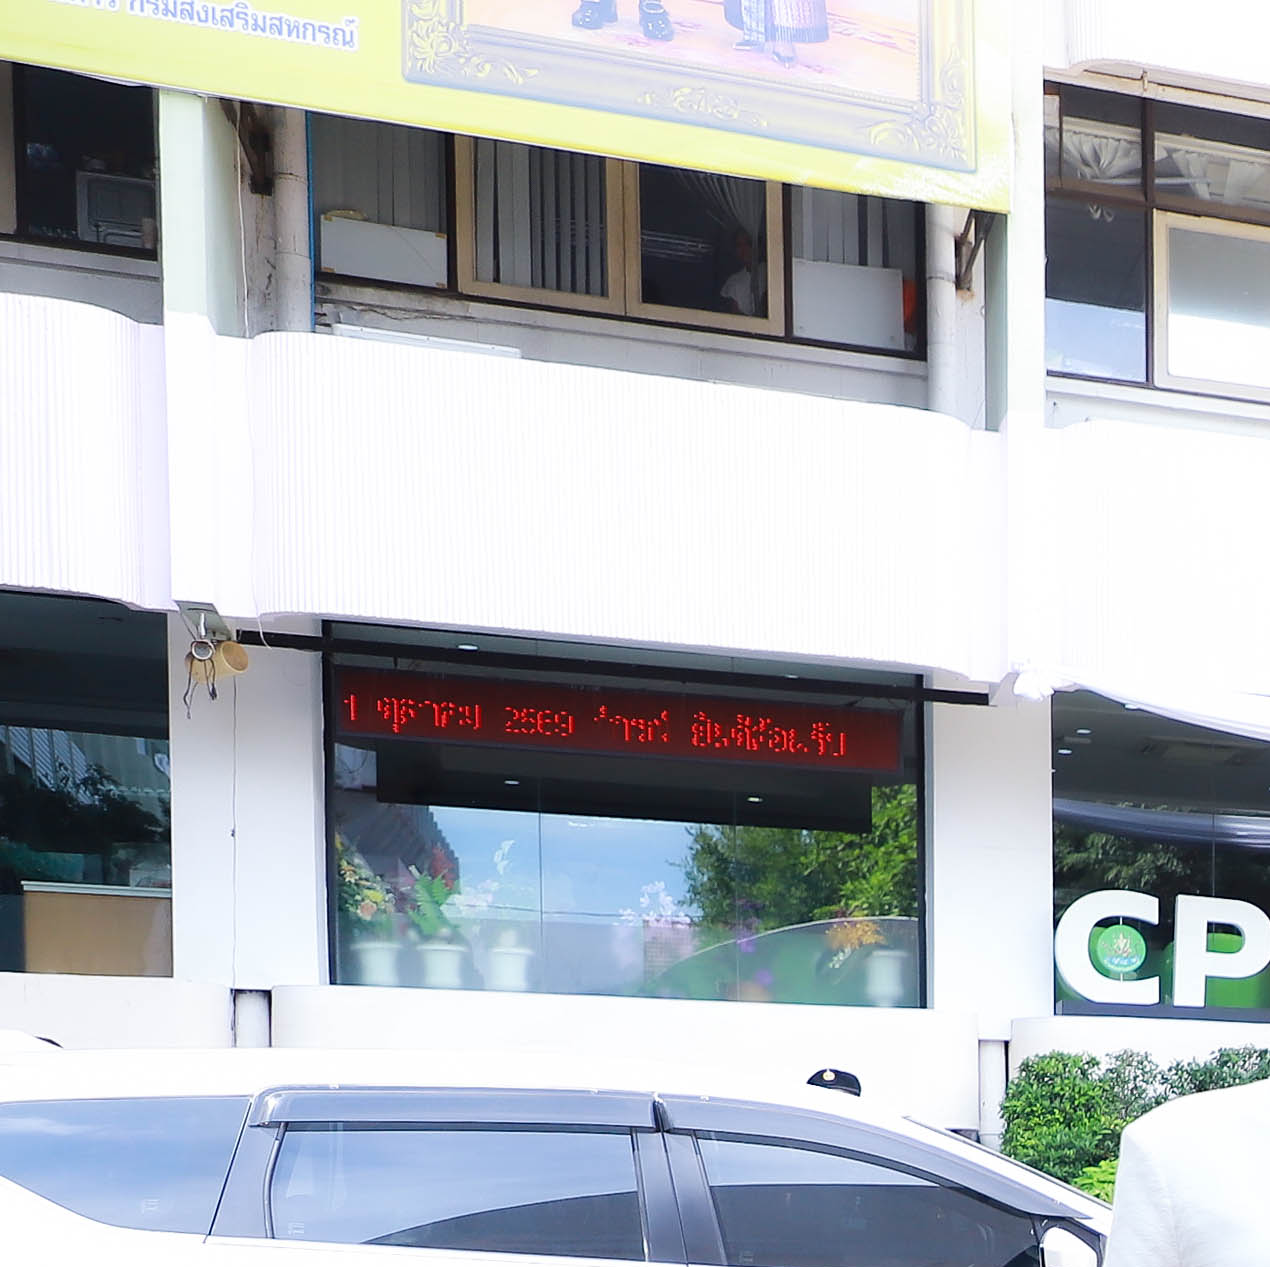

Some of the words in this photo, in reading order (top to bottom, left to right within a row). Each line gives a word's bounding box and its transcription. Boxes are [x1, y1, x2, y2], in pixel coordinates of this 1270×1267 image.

[128, 0, 356, 49] กรมสงเสริมสหกรณ์
